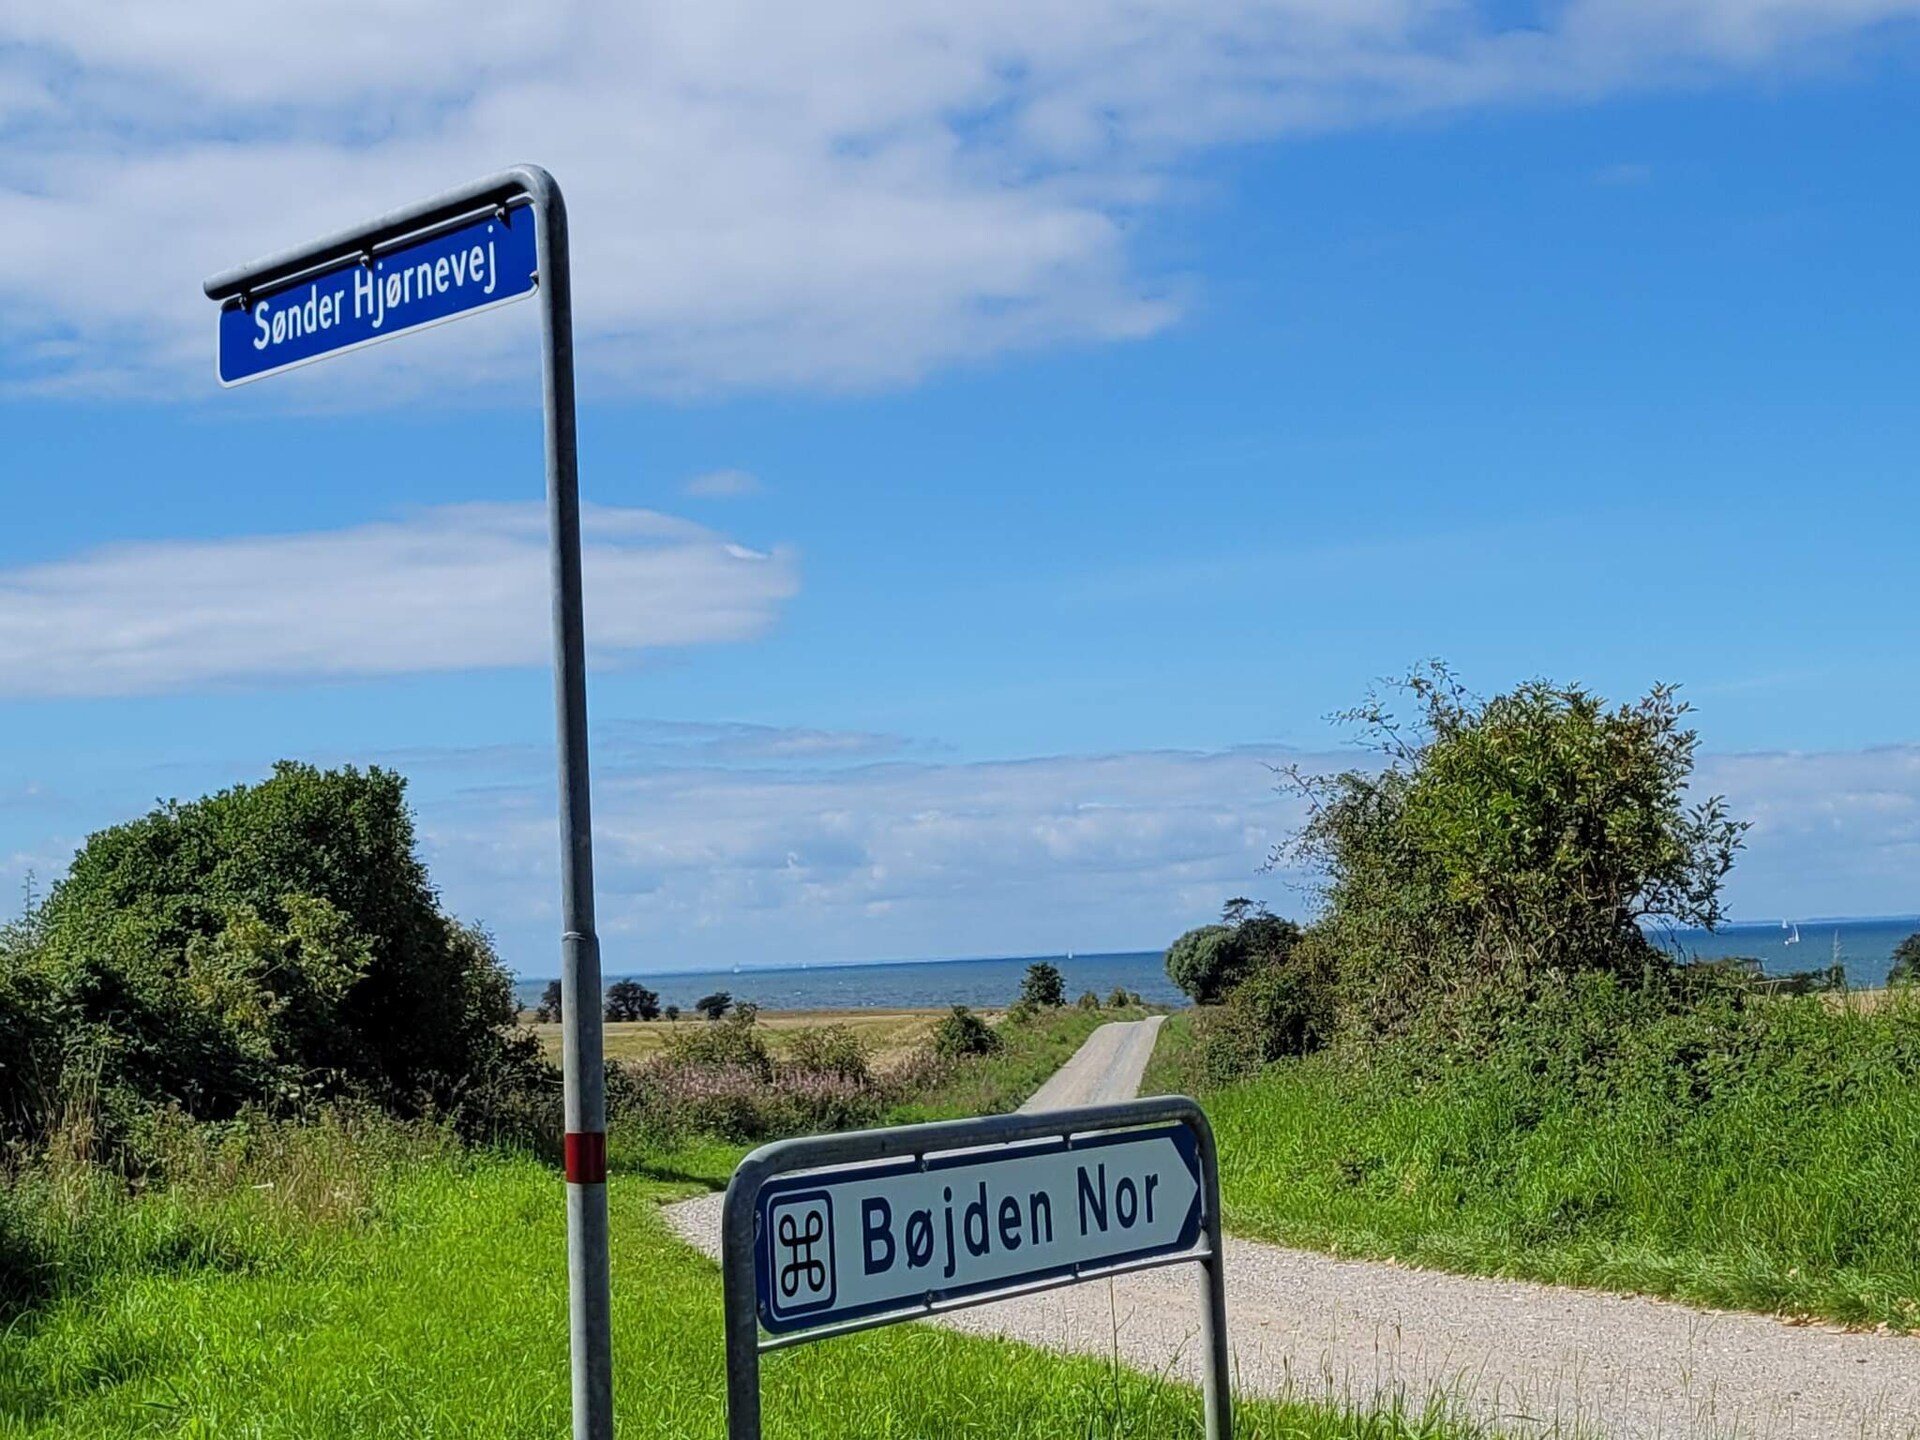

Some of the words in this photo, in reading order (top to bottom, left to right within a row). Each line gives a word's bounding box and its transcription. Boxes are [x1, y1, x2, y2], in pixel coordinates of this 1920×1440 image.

[253, 284, 345, 350] Sønder
[354, 225, 496, 328] Hjørnevej
[861, 1182, 1053, 1279] Bøjden
[1077, 1163, 1159, 1236] Nor
